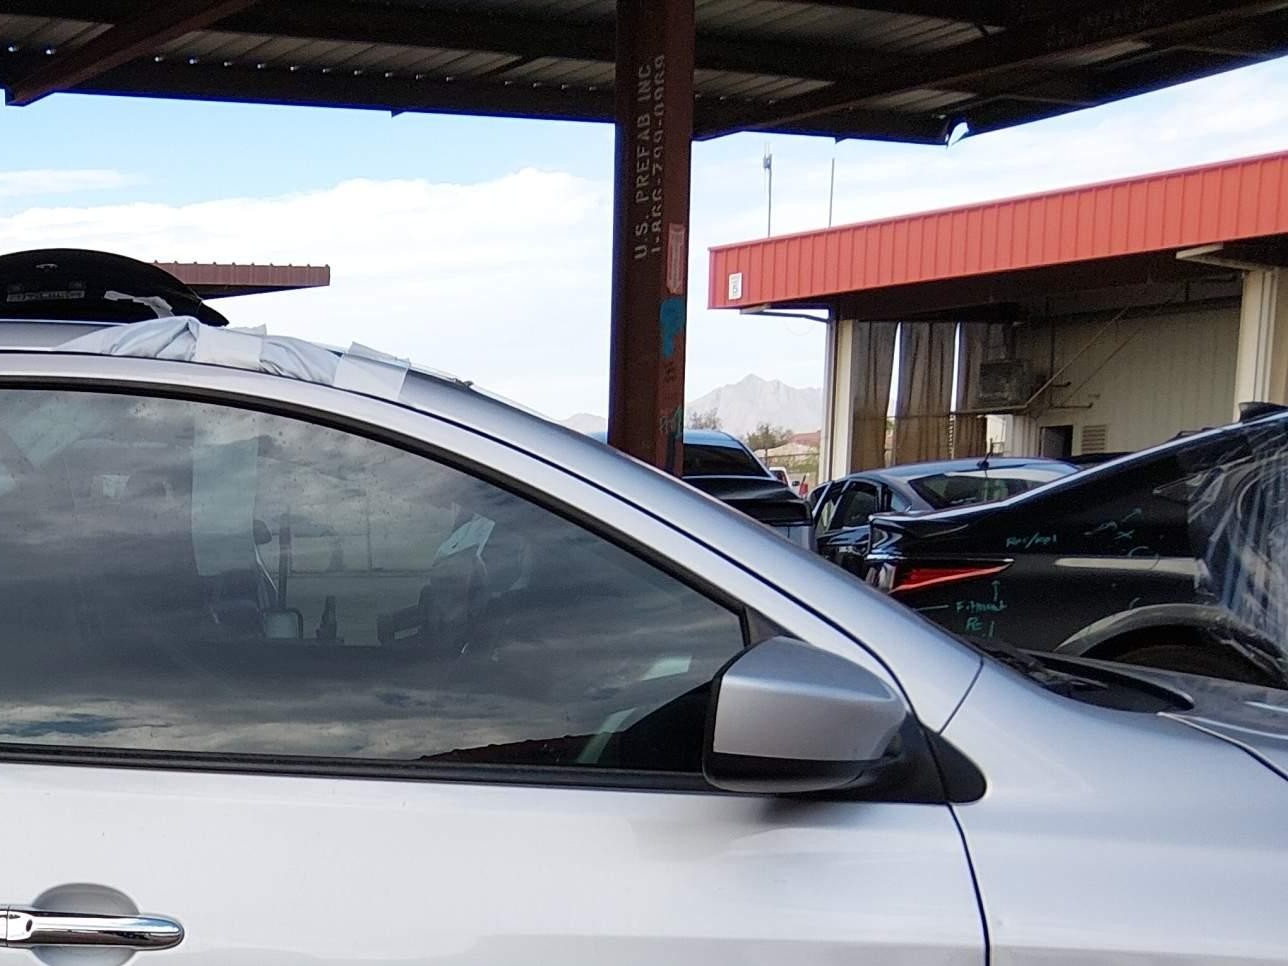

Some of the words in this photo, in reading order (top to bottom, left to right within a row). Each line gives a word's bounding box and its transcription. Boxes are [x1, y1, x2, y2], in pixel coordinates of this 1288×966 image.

[638, 63, 651, 102] INC
[635, 113, 651, 204] PREFAB
[635, 214, 649, 259] U.S.
